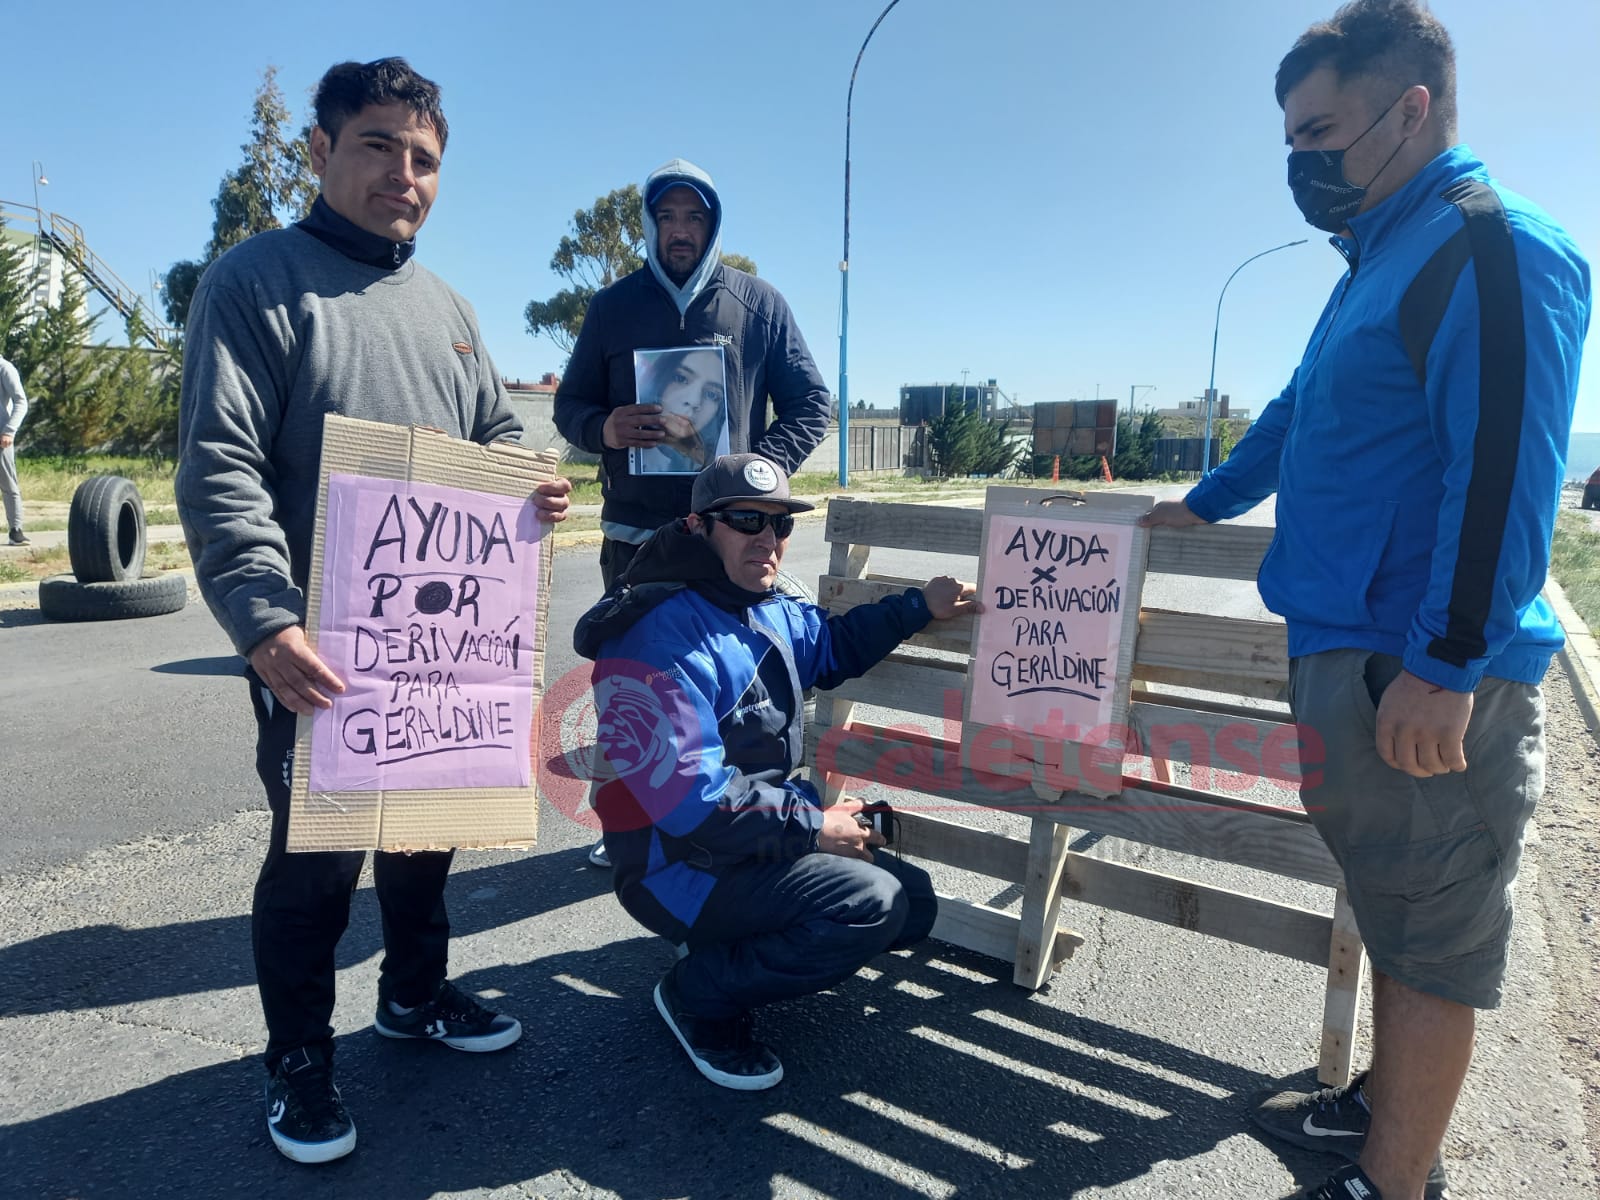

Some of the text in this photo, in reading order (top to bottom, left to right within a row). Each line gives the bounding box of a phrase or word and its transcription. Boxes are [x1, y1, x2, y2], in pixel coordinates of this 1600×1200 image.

[363, 494, 515, 571] AYUDA
[1004, 526, 1110, 566] AYUDA
[367, 573, 481, 626] POR
[1011, 616, 1068, 647] PARA
[389, 669, 461, 703] PARA
[991, 646, 1108, 690] GERALDINE
[341, 698, 515, 757] GERALDINE
